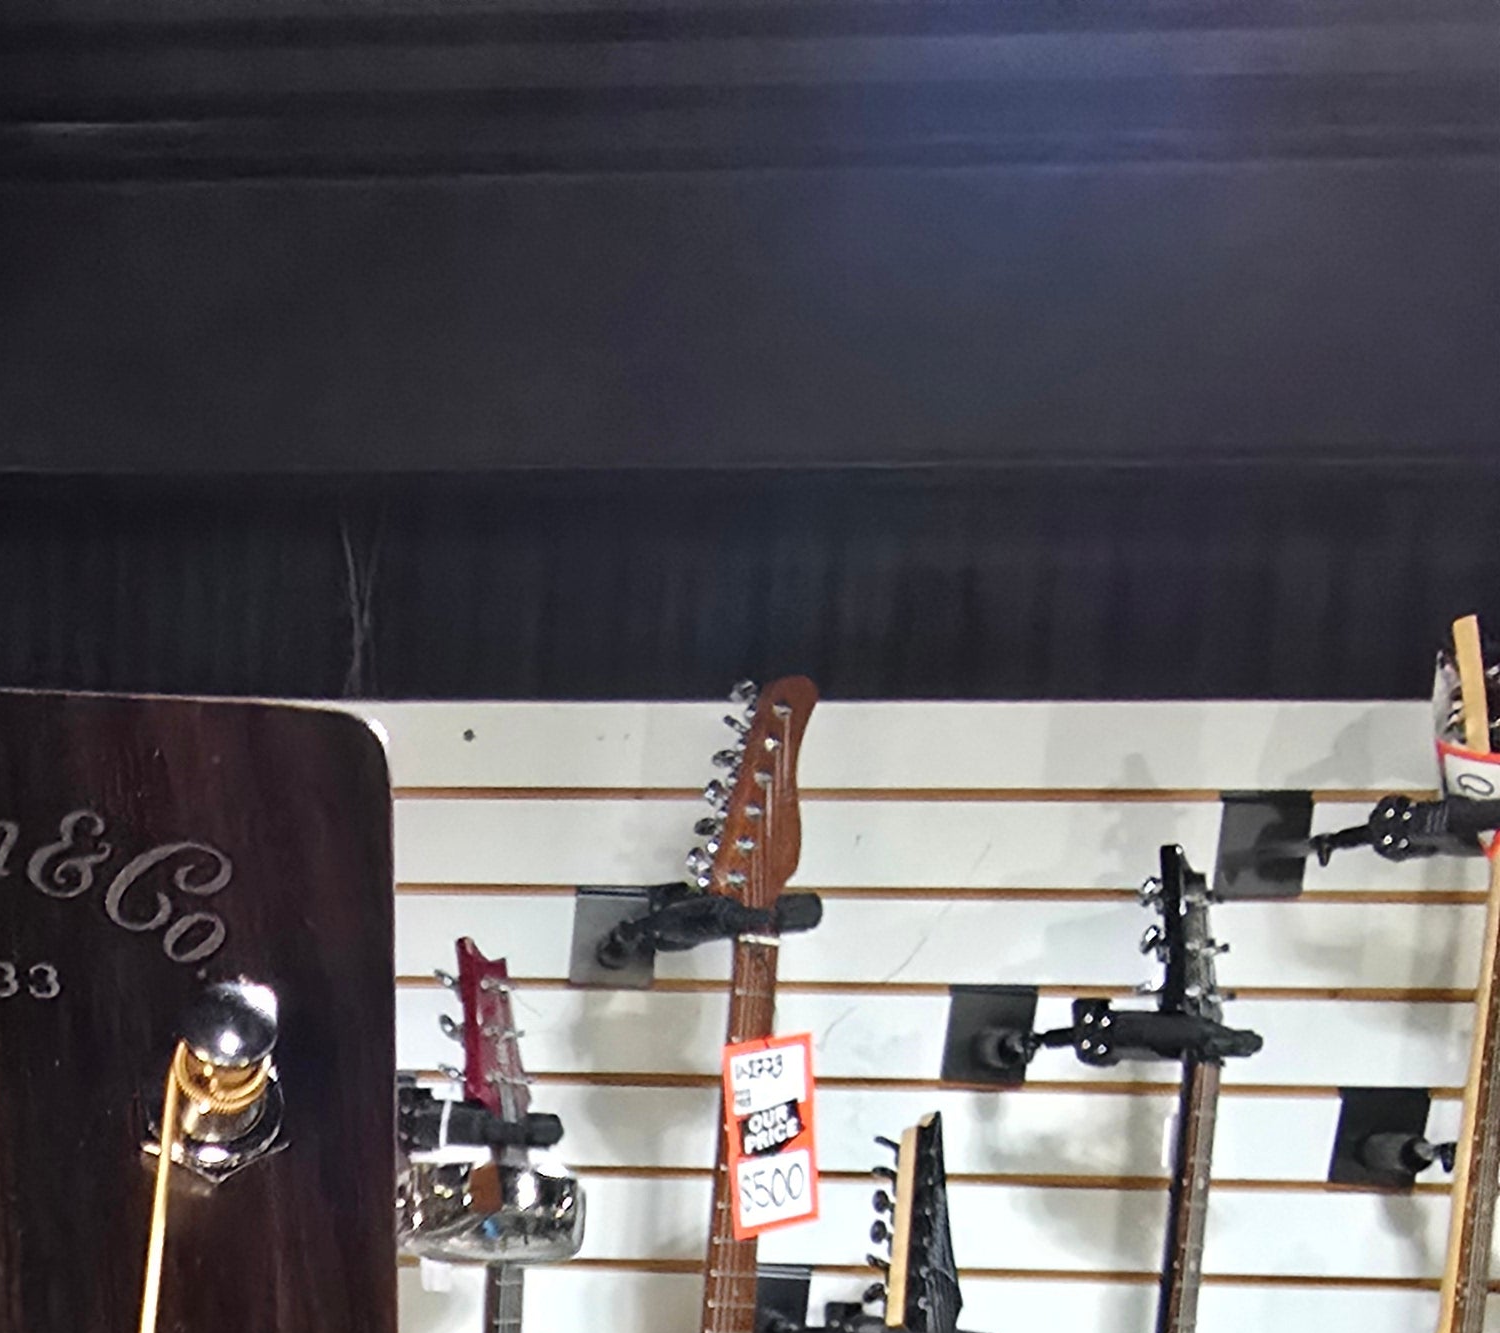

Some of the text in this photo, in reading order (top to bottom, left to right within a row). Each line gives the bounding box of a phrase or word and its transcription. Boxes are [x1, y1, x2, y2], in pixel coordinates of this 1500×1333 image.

[744, 1117, 799, 1155] PRICE
[748, 1103, 790, 1134] OUR
[740, 1163, 804, 1213] $500
